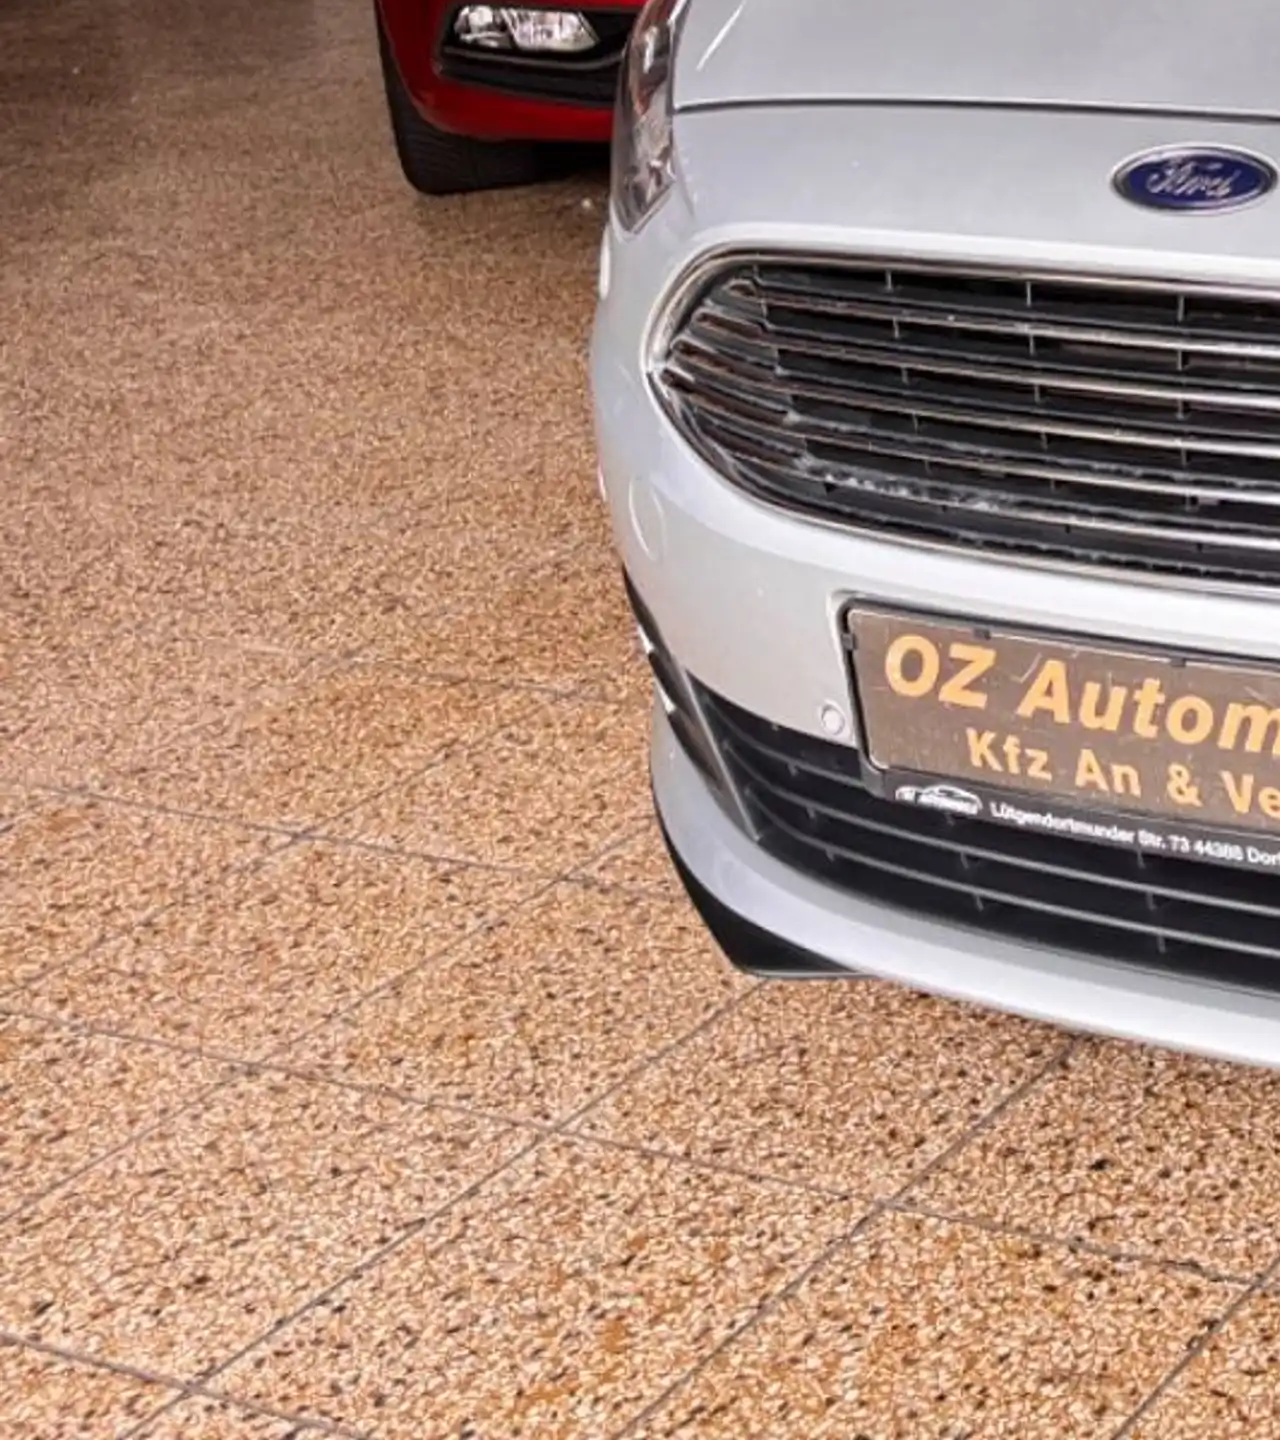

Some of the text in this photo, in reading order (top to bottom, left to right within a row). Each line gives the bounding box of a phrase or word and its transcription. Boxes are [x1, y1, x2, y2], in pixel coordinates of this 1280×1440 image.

[1146, 161, 1243, 198] Ford
[884, 633, 997, 710] OZ
[965, 727, 1053, 782] Kfz
[1074, 748, 1142, 799] An
[1166, 762, 1204, 808] &
